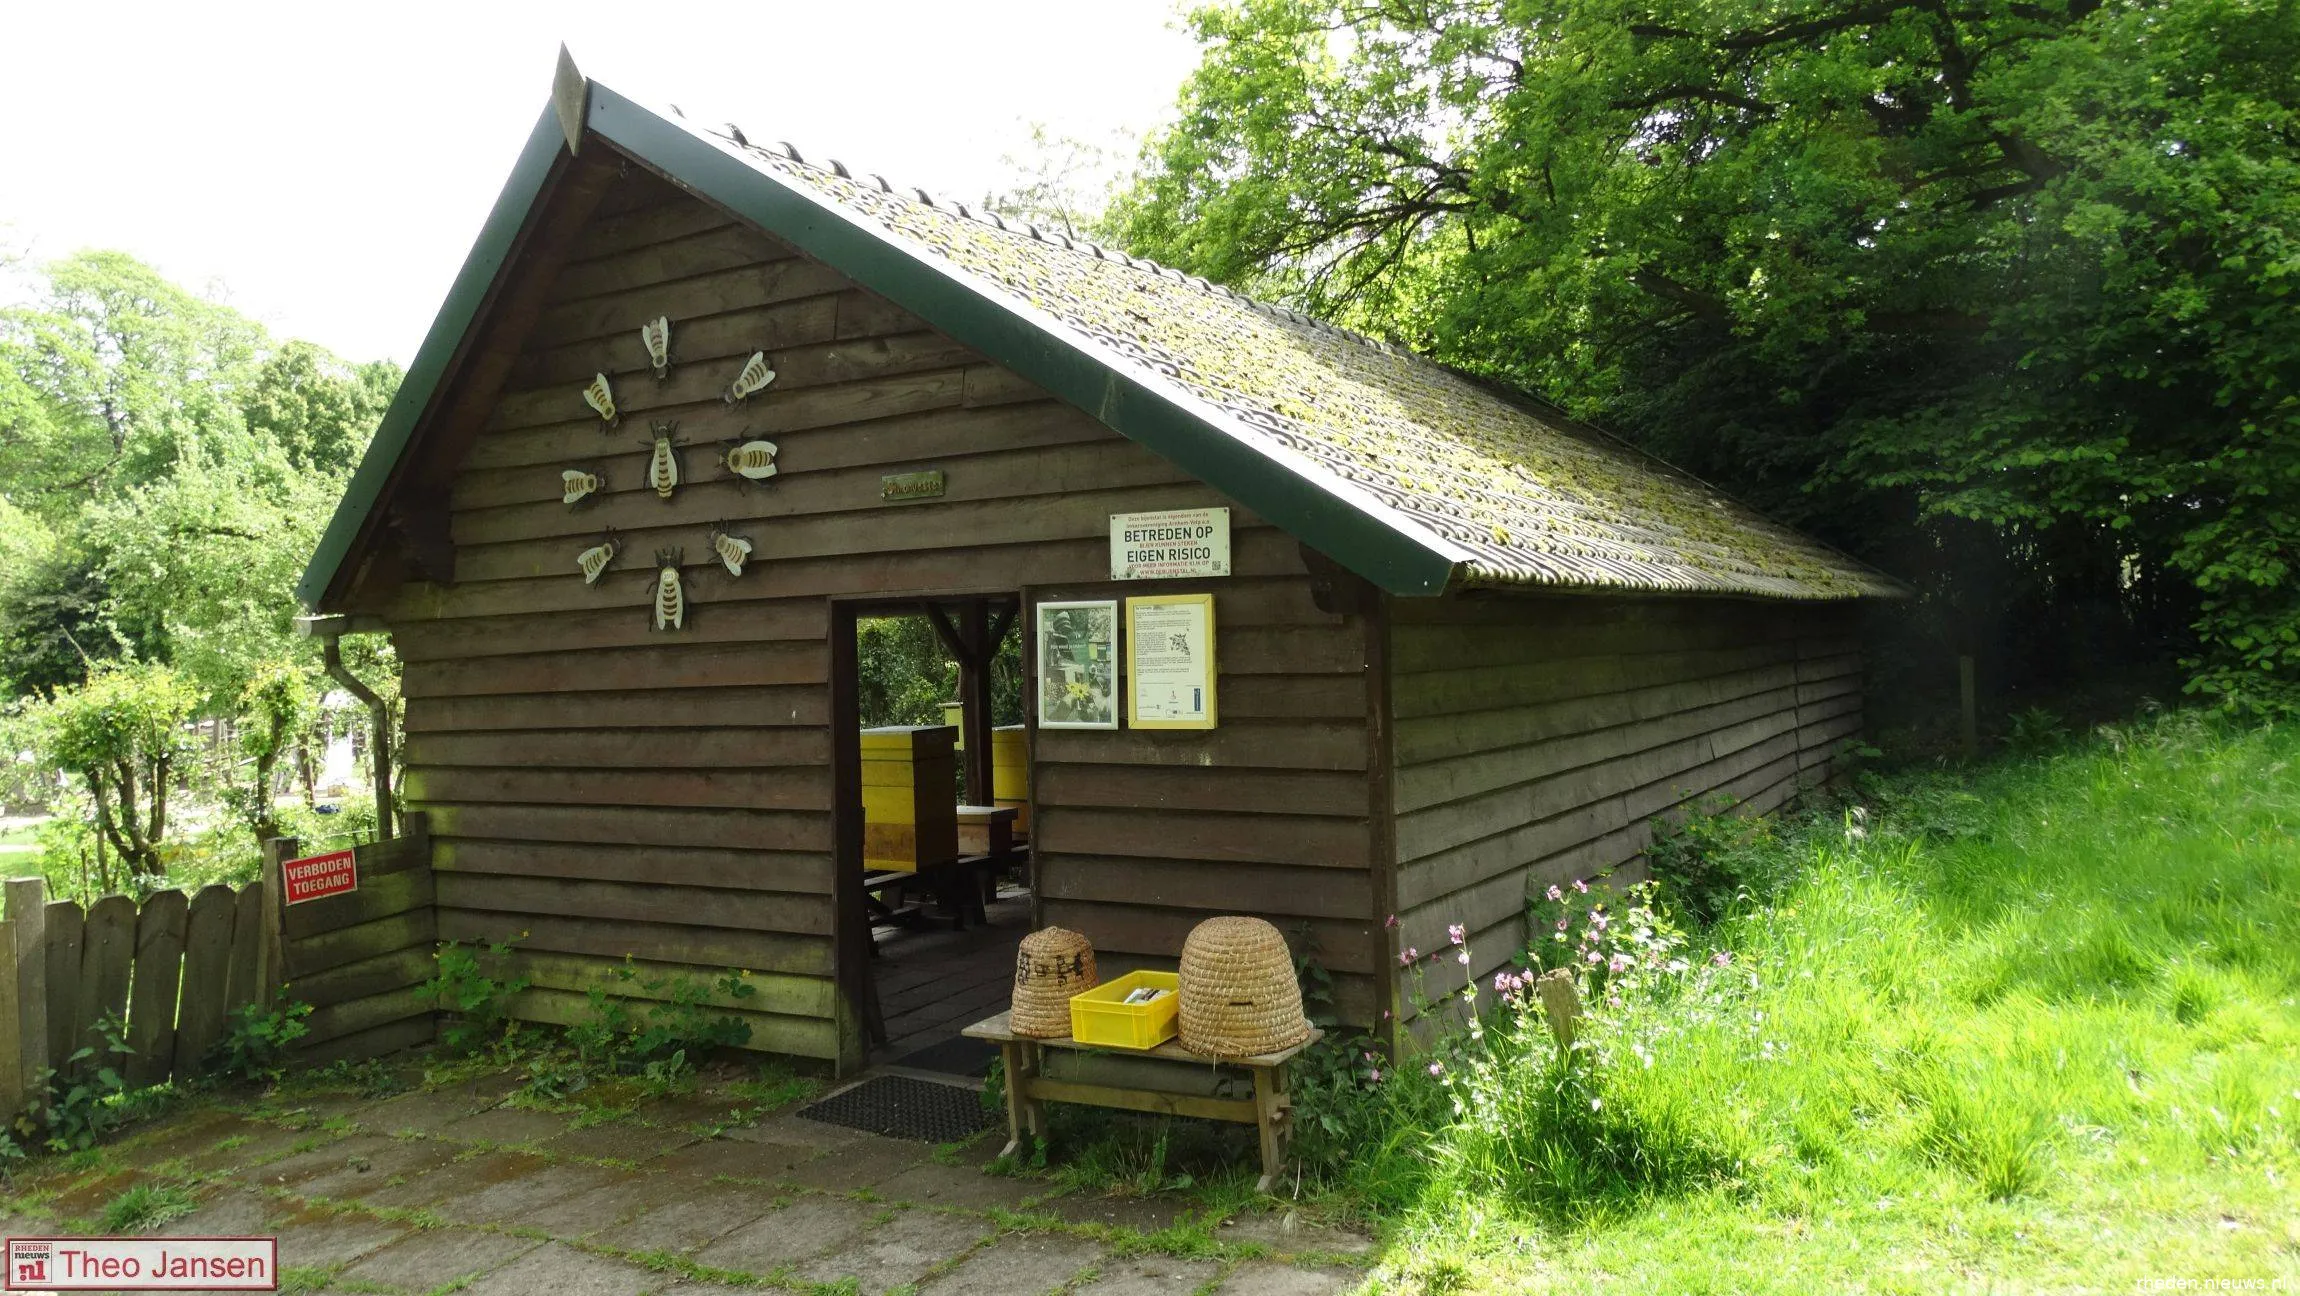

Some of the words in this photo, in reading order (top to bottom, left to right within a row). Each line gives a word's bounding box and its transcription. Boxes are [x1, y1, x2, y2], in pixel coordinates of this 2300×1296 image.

[1124, 528, 1192, 543] BETREDEN
[1196, 526, 1214, 539] OP
[1127, 549, 1165, 563] EIGEN
[1169, 547, 1211, 561] RISICO
[288, 857, 352, 881] VERBODEN
[293, 873, 350, 895] TOEGANG
